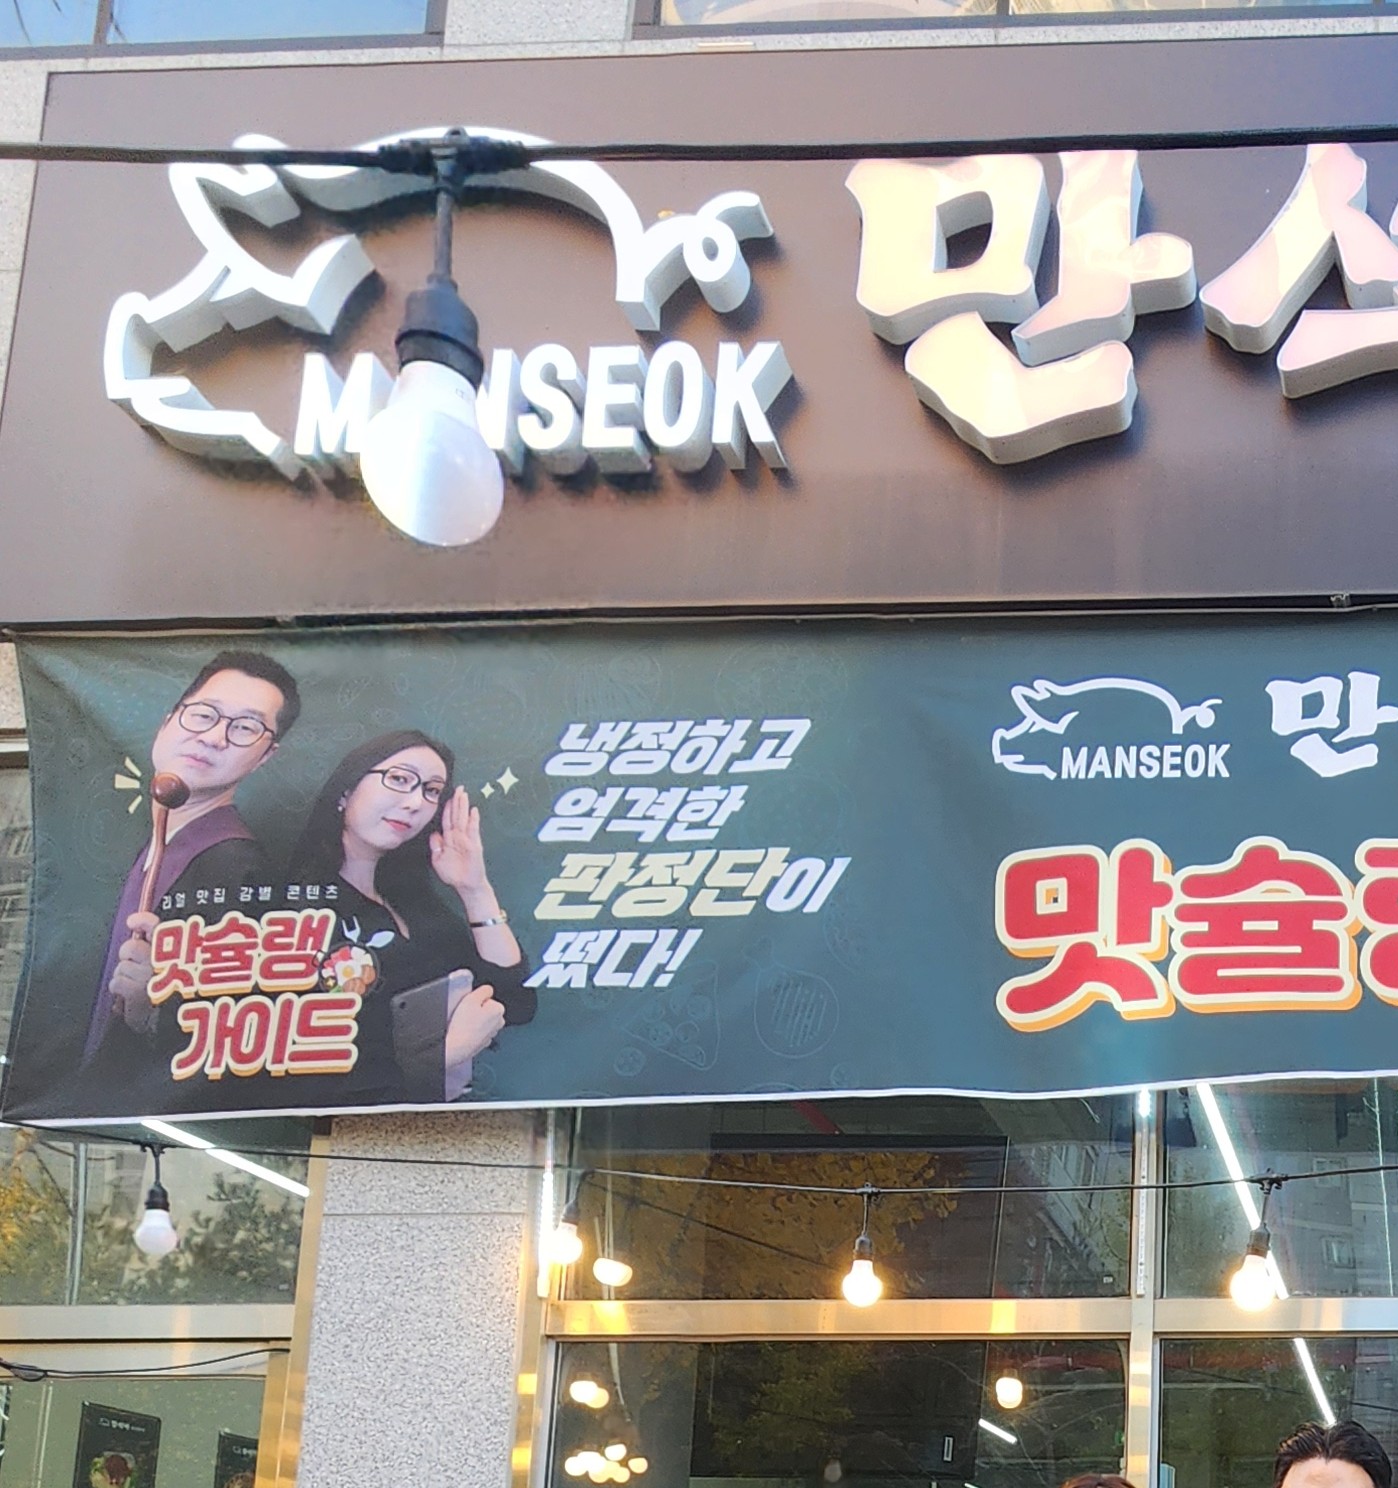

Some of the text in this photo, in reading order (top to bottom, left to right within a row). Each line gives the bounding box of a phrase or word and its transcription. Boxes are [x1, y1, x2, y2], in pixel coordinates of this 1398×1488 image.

[294, 341, 800, 474] MNSEOK
[544, 719, 812, 776] 냉정하고
[1060, 743, 1231, 779] MANSEOK
[537, 785, 749, 842] 엄격한
[196, 887, 226, 904] 맛집
[239, 886, 272, 902] 감별
[533, 847, 852, 920] 판정단이
[147, 908, 336, 1006] 맛슐랭
[522, 929, 703, 988] 떴다!
[171, 992, 362, 1080] 가이드
